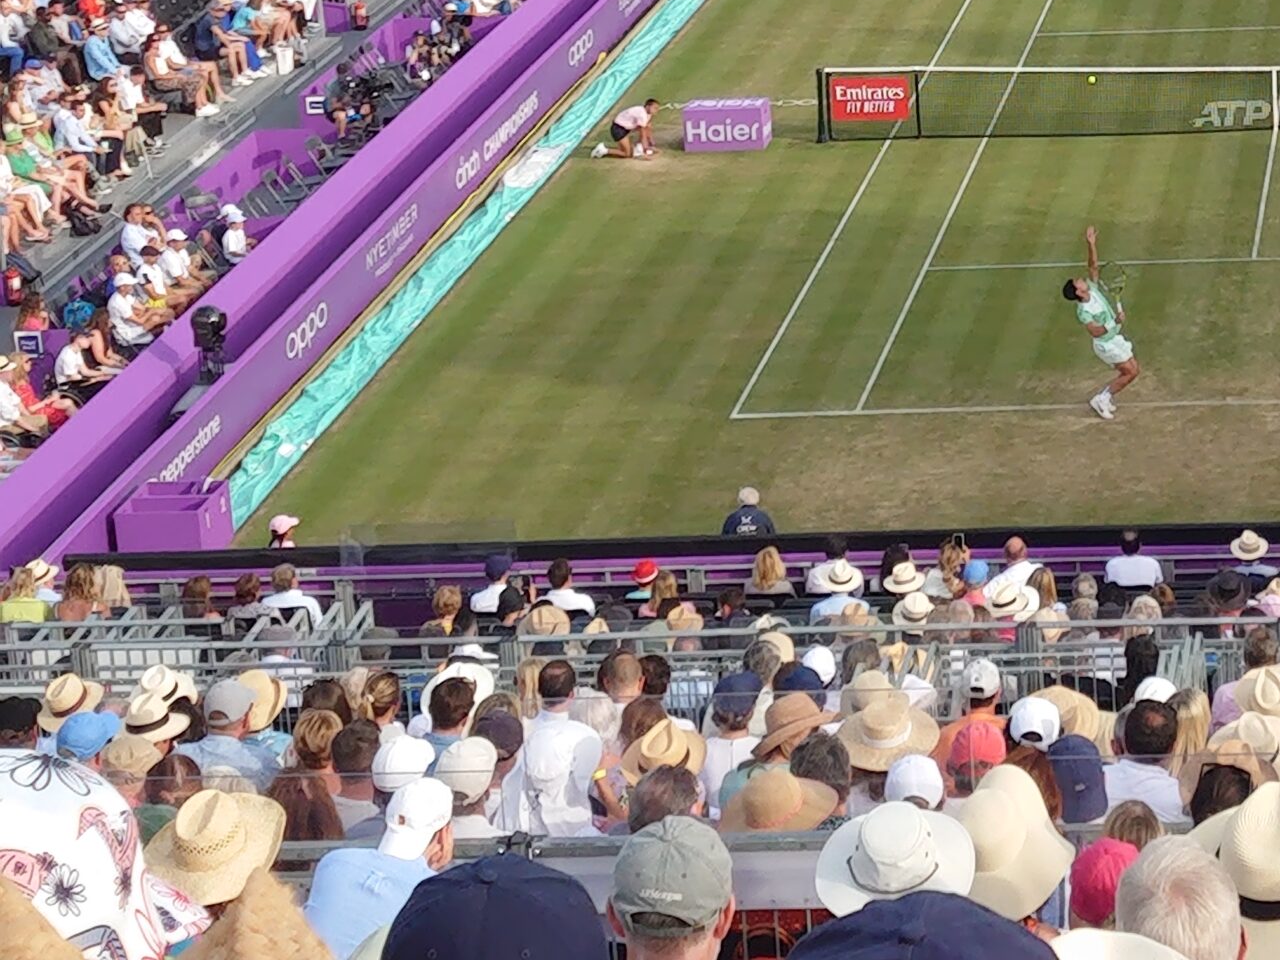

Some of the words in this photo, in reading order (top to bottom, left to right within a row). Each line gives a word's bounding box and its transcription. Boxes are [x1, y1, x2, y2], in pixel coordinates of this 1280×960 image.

[568, 28, 594, 67] oppo
[835, 84, 905, 100] Emirates
[846, 100, 861, 113] FLY
[863, 100, 895, 113] BETTER
[686, 118, 760, 143] Haier
[1189, 99, 1272, 128] ATP
[455, 149, 480, 190] cinch
[483, 90, 539, 162] CHAMPIONSHIPS
[366, 203, 418, 271] NYETIMBER
[286, 302, 328, 359] oppo
